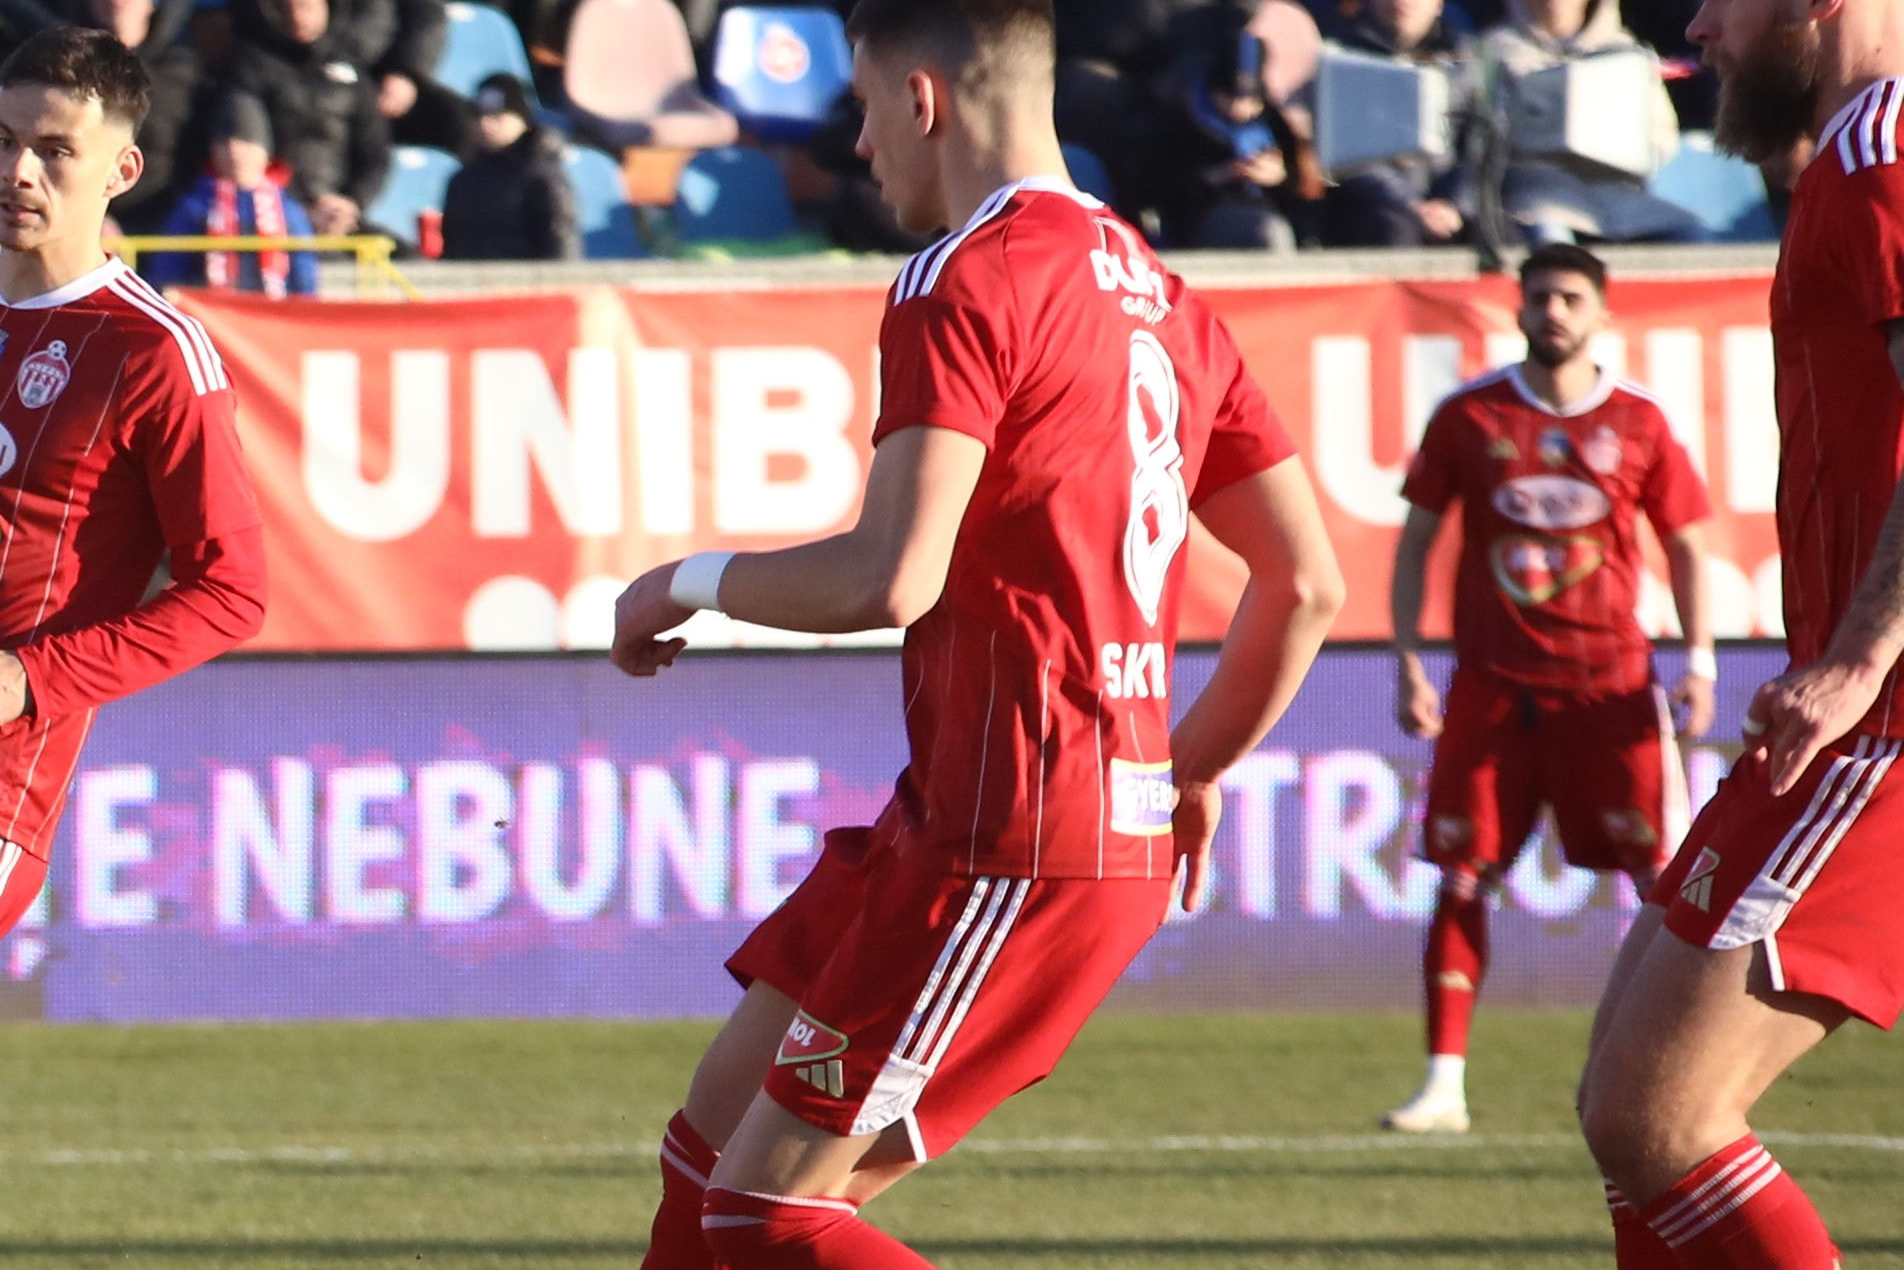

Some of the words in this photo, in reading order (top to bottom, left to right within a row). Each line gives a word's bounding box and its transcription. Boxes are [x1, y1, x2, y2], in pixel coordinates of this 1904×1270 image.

[302, 347, 881, 542] UNIB
[1123, 330, 1189, 627] 8
[212, 755, 822, 930] NEBUNE
